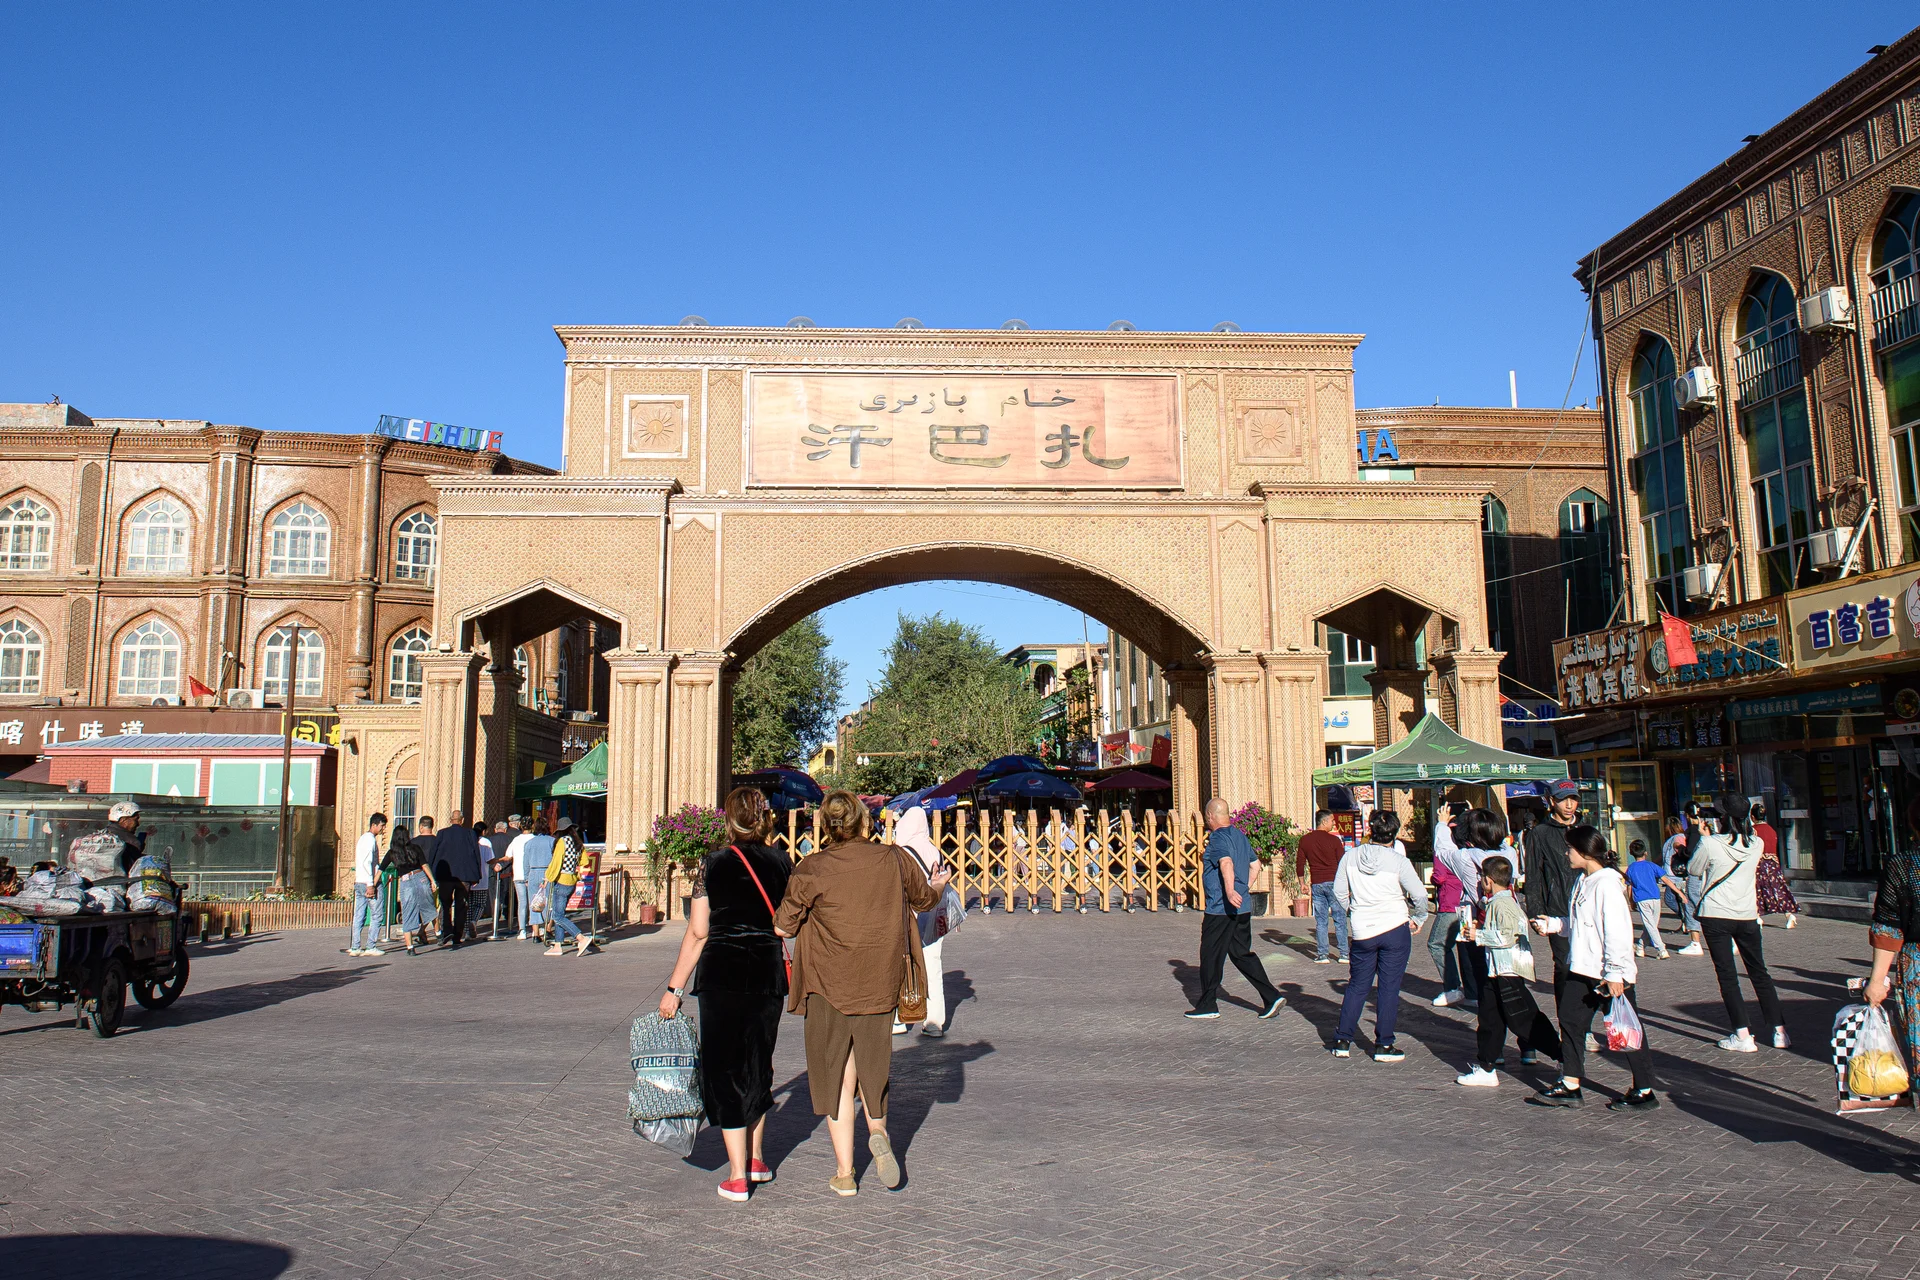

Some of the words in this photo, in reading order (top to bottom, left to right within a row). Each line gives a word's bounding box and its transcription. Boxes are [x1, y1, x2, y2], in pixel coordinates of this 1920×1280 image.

[1000, 387, 1076, 417] خام
[800, 423, 1130, 469] 汗巴扎
[1807, 595, 1896, 650] 百客吉
[1566, 663, 1639, 708] 光地宾馆
[1444, 763, 1481, 775] 亲近自然
[1490, 763, 1528, 775] 统一绿茶
[638, 1056, 676, 1068] DELICATE
